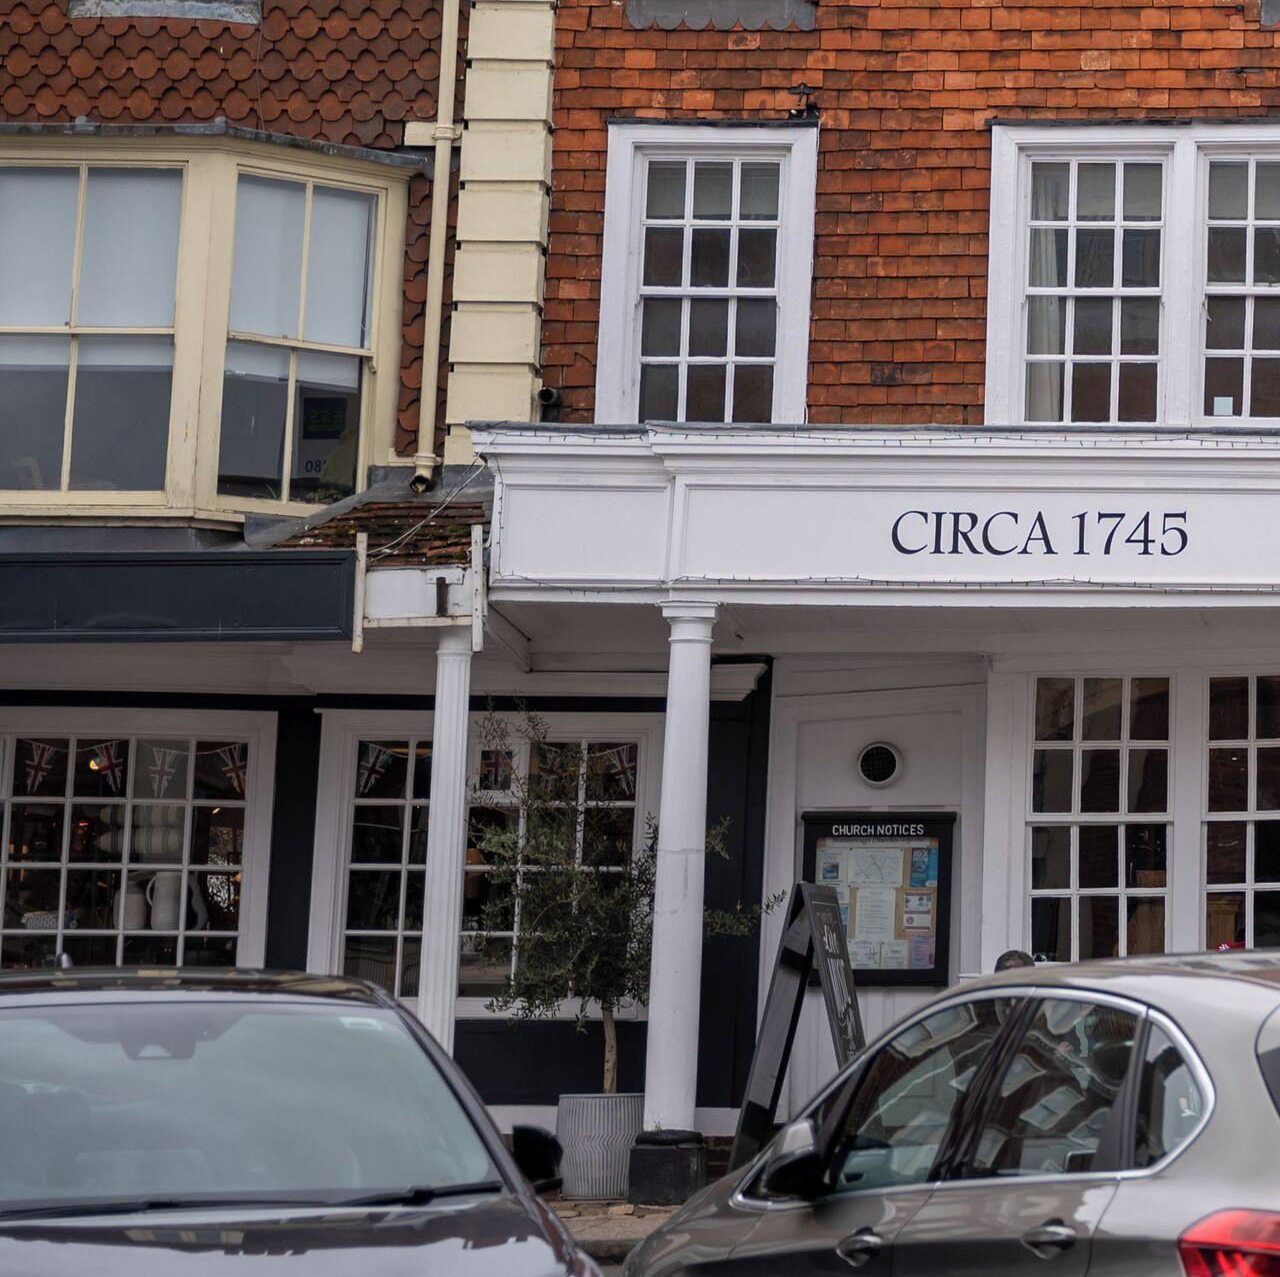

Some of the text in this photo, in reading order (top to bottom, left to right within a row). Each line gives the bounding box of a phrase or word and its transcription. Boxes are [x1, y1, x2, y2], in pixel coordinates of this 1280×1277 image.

[890, 510, 1190, 557] CIRCA 1745
[832, 824, 925, 836] CHURCH NOTICES
